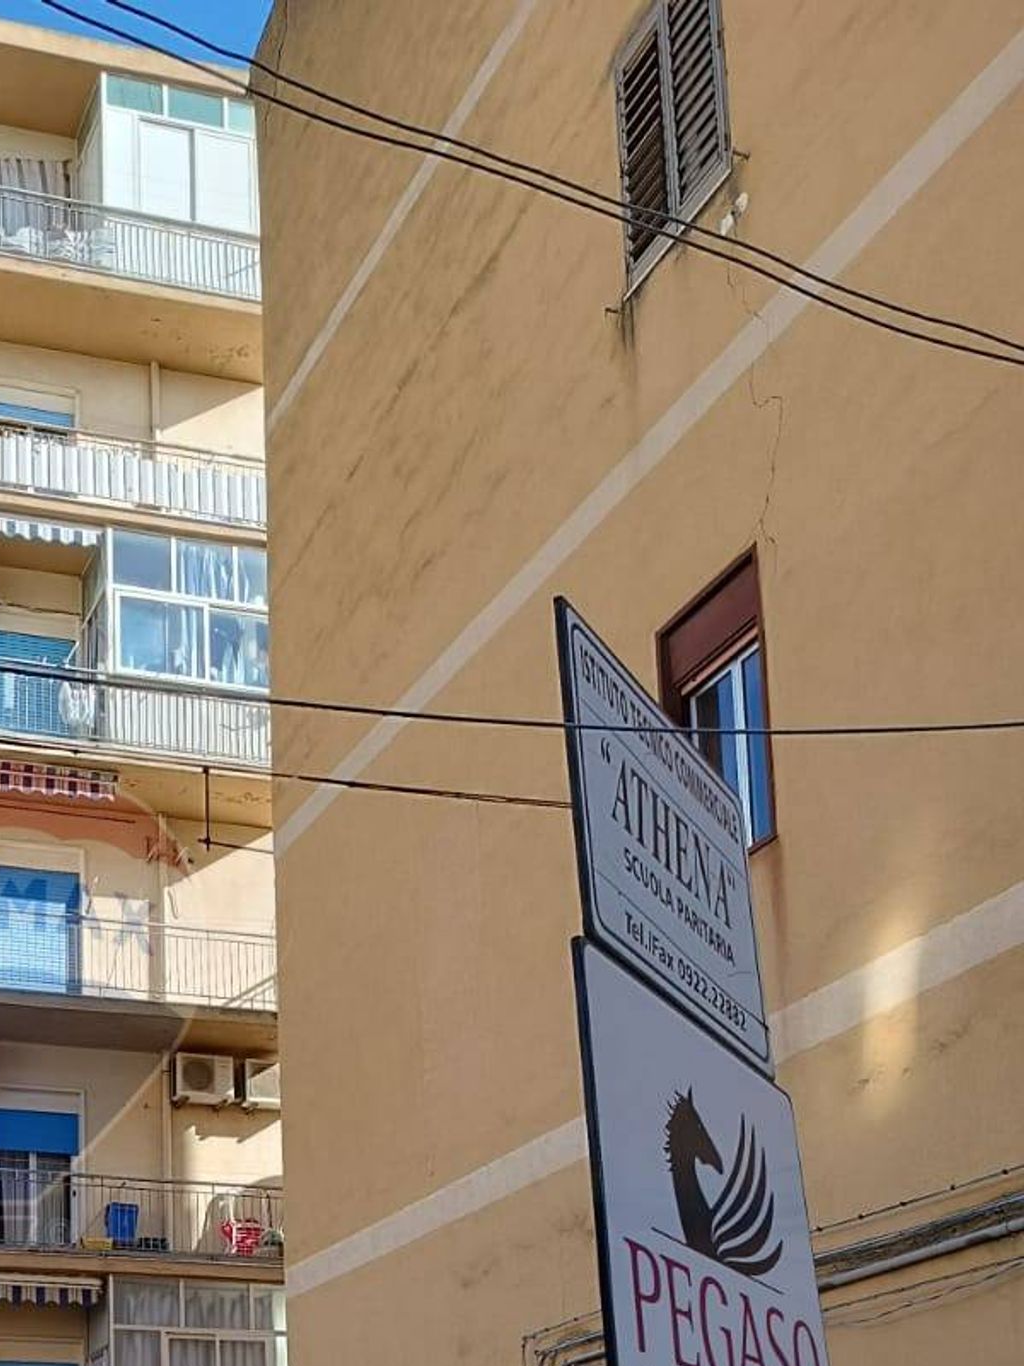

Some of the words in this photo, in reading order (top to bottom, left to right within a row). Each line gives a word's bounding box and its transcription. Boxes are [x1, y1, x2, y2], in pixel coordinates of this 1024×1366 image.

[579, 644, 628, 725] ISTITUTO
[623, 846, 675, 913] SCUOLA
[676, 897, 736, 968] PARITARIA
